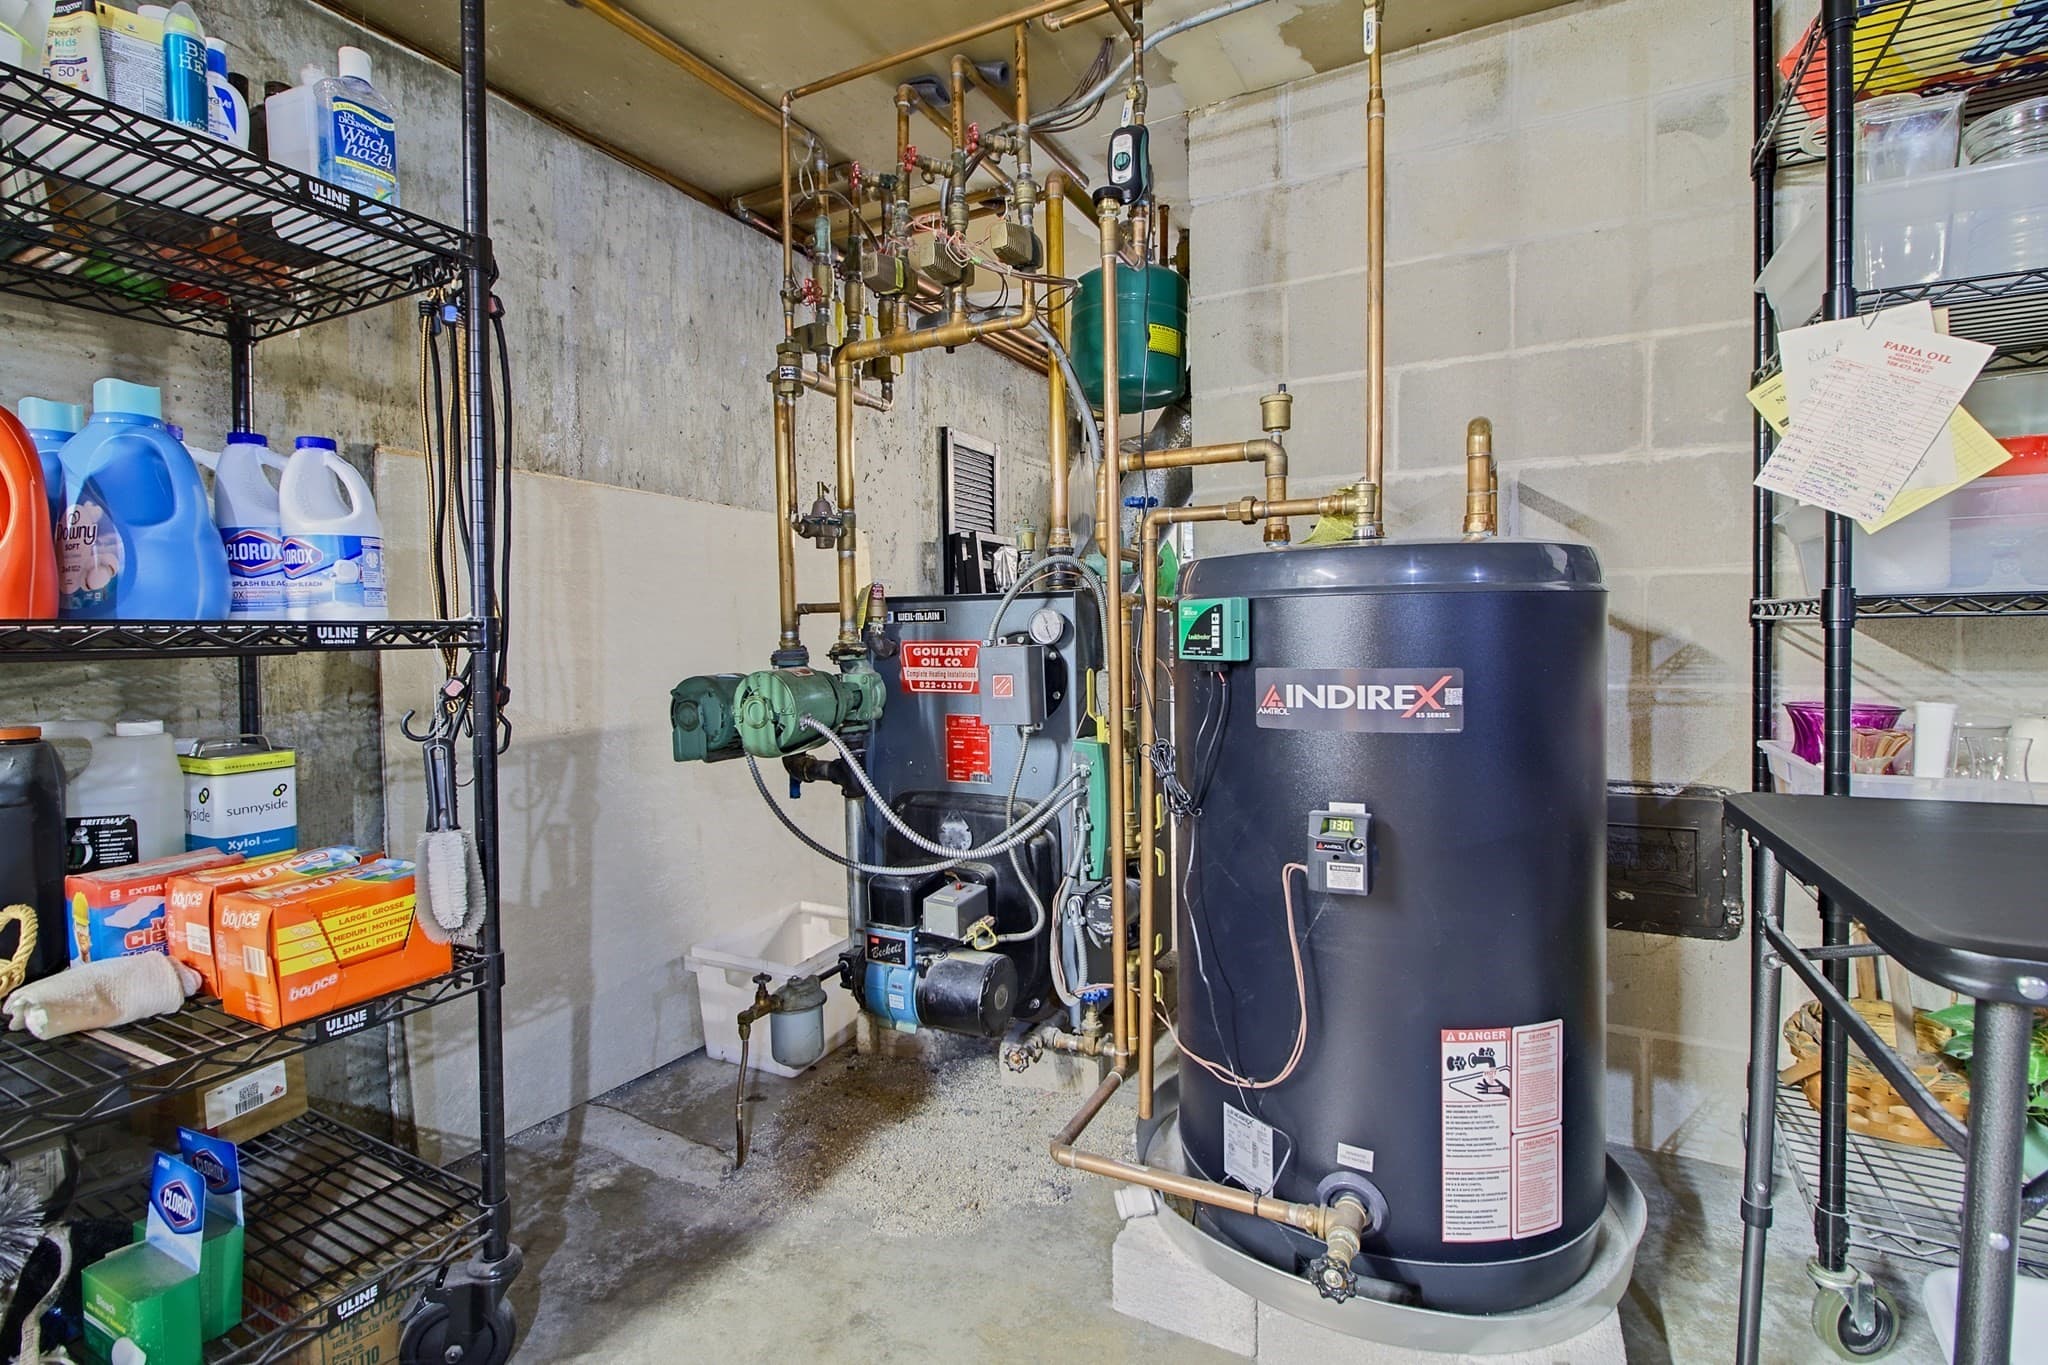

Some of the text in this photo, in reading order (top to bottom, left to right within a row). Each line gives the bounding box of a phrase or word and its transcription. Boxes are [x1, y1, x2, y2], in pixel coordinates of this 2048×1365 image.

[54, 38, 76, 47] kids
[338, 123, 389, 156] Witch
[344, 140, 393, 170] hazel
[308, 181, 350, 207] ULINE
[1883, 341, 1922, 356] FARIA
[1927, 352, 1953, 364] OIL
[56, 524, 97, 546] Downy
[65, 543, 80, 551] SOFT
[226, 543, 283, 561] CLOROX
[317, 626, 358, 639] ULINE
[913, 647, 970, 657] GOULART
[921, 657, 963, 667] OIL CO.
[907, 669, 977, 679] Complete Heating Installations
[919, 681, 964, 690] 822-6316
[1286, 675, 1453, 719] INDIREX
[1256, 707, 1291, 716] AMTROL
[226, 798, 289, 817] sunnyside
[228, 836, 260, 851] Xylol
[110, 885, 162, 900] 8 EXTRA
[171, 887, 203, 910] bounce
[222, 907, 261, 929] bounce
[338, 902, 405, 926] LARGE GROSSE
[333, 913, 410, 943] MEDIUM MOYENNE
[342, 931, 404, 956] SMALL PETITE
[871, 942, 903, 959] Beckett
[289, 973, 339, 1003] bounce
[326, 1009, 368, 1032] ULINE
[1458, 1031, 1507, 1041] DANGER
[194, 1156, 226, 1183] CLOROX
[164, 1188, 193, 1221] CLOROX
[337, 1285, 379, 1316] ULINE
[327, 1286, 413, 1340] CIRCULAT
